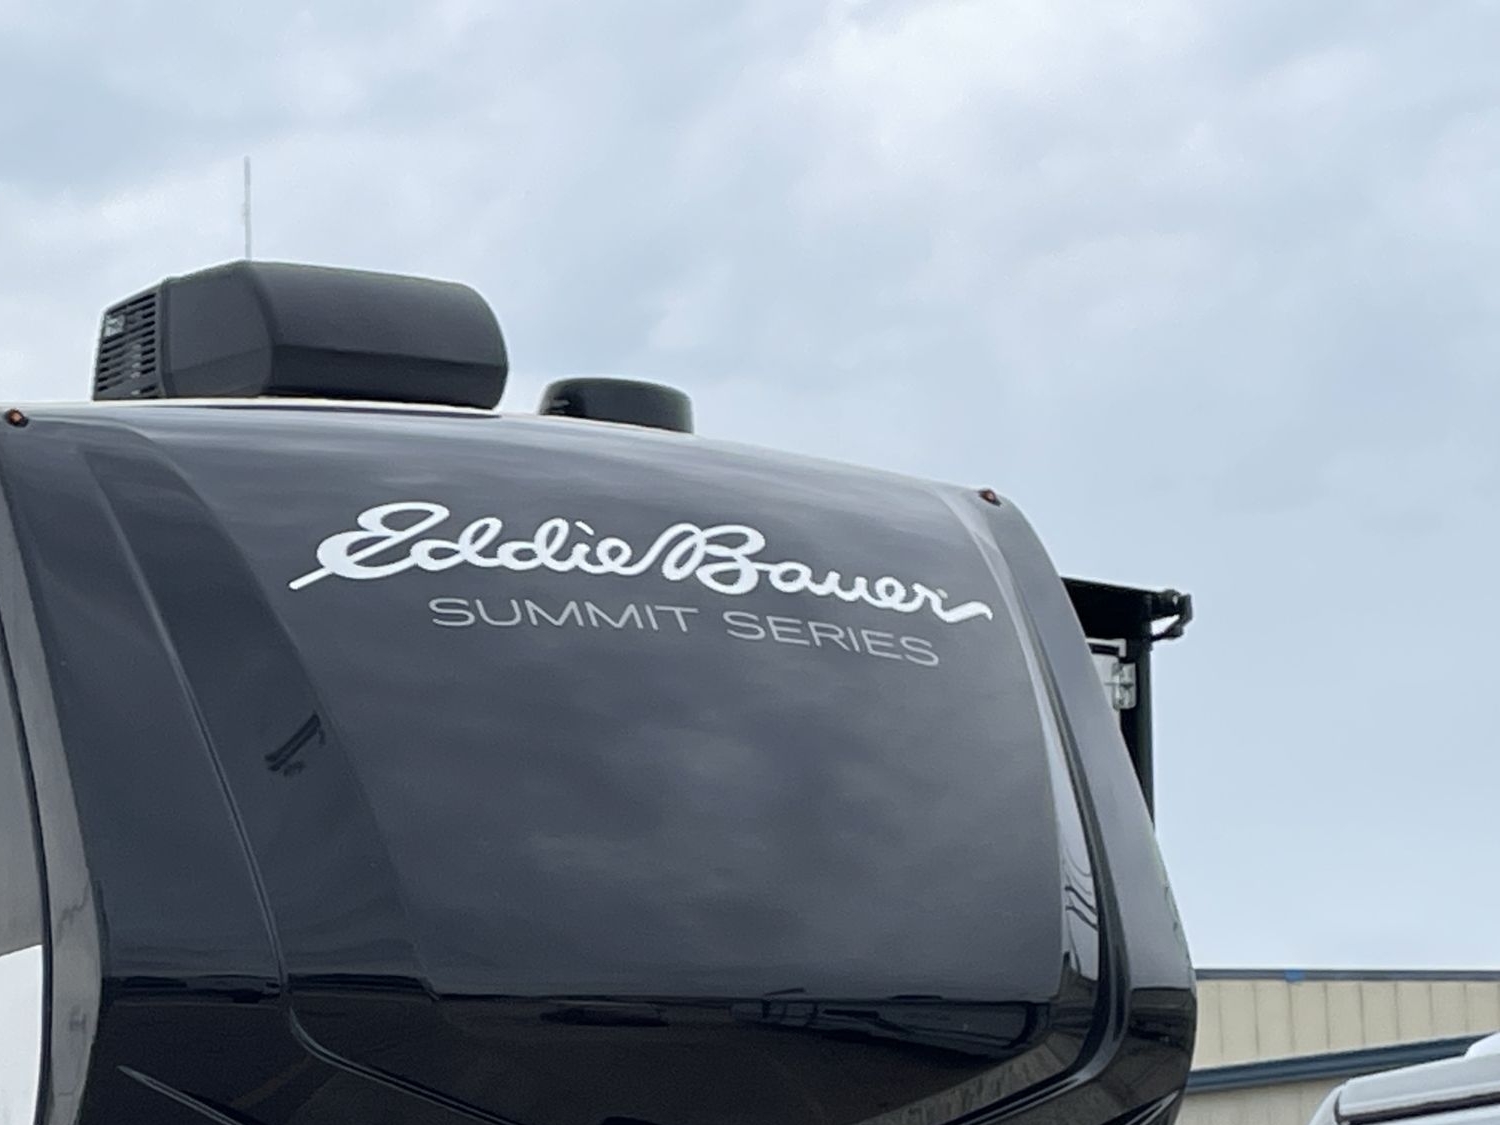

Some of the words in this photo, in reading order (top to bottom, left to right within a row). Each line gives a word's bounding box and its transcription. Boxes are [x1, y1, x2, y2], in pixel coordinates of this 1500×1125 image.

[289, 502, 638, 589] Eddie
[658, 522, 993, 622] Bauer
[429, 598, 699, 633] SUMMIT
[722, 610, 940, 667] SERIES
